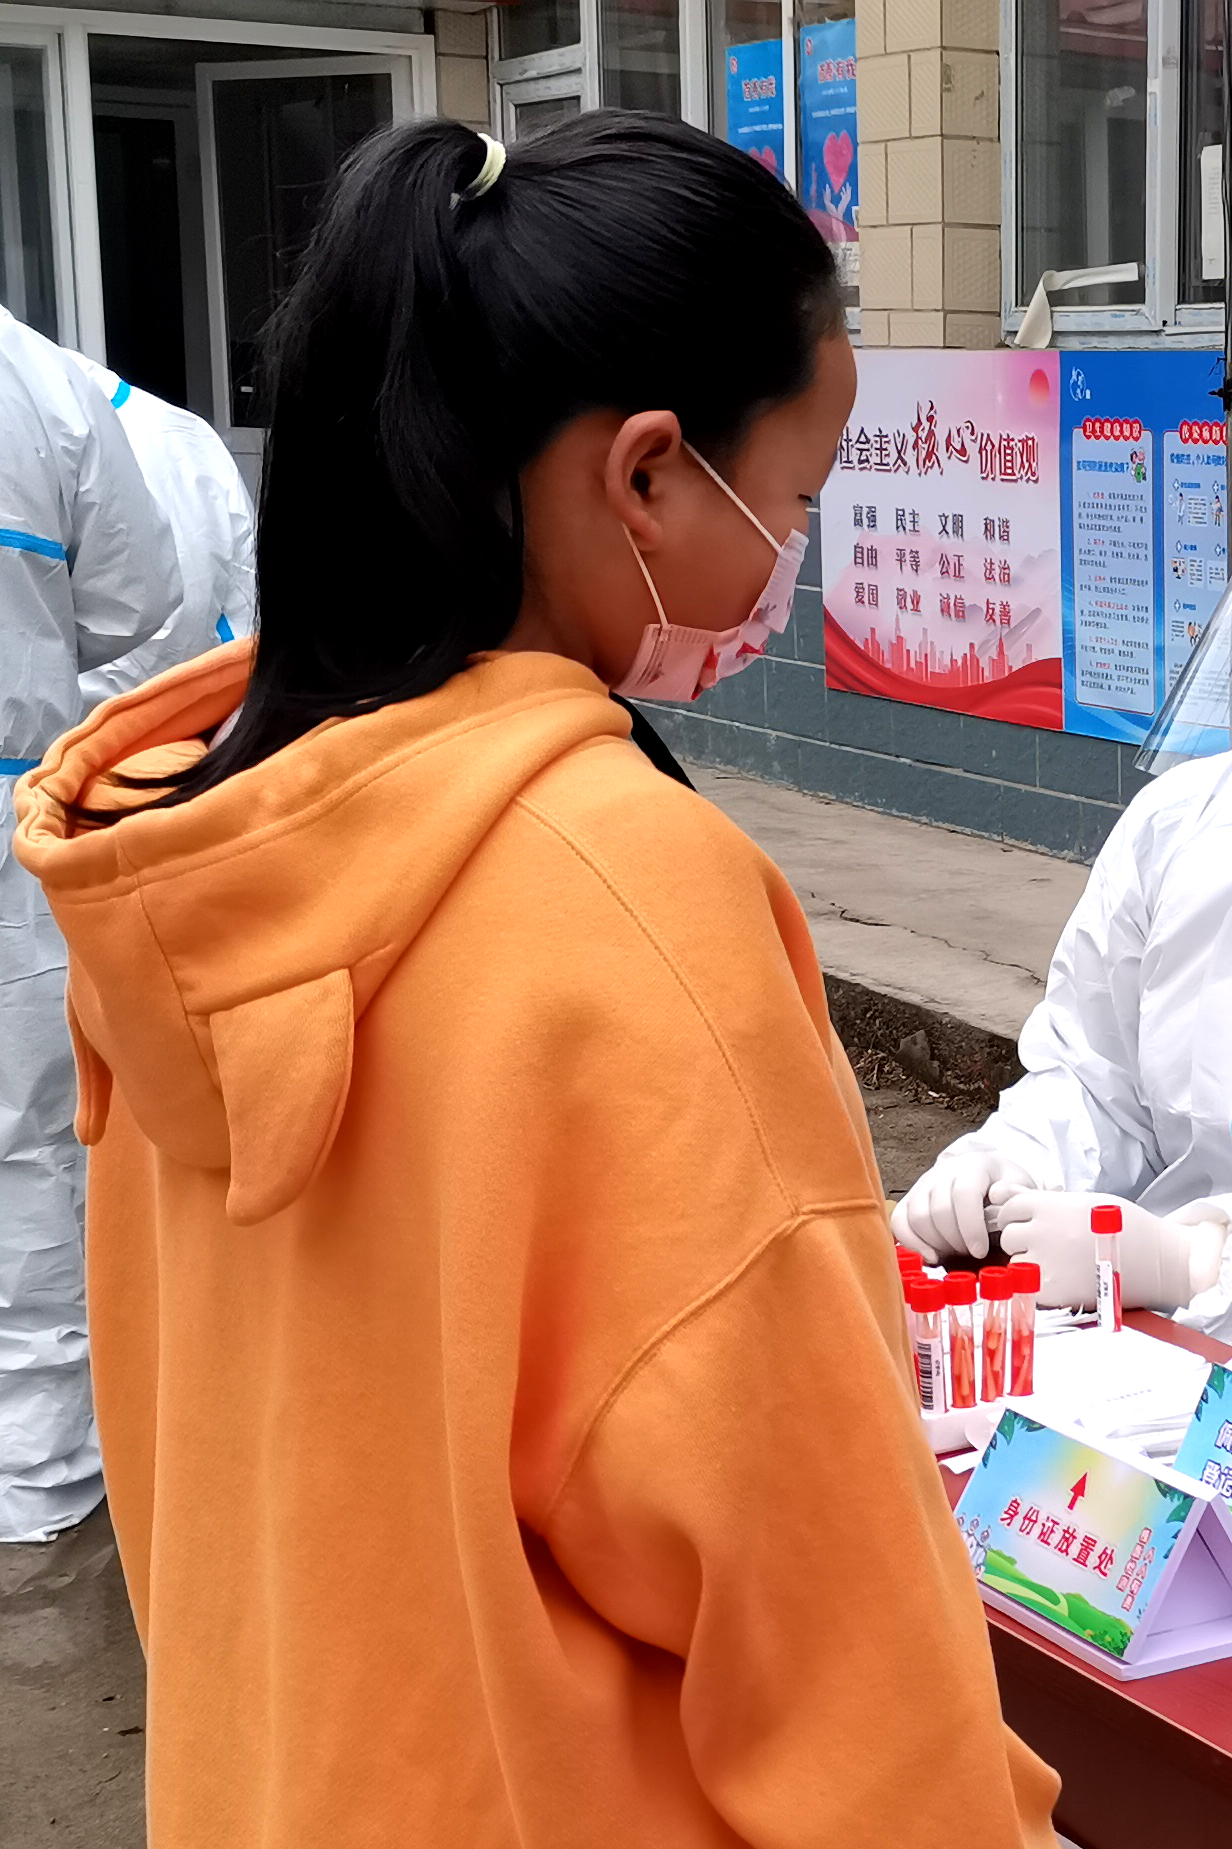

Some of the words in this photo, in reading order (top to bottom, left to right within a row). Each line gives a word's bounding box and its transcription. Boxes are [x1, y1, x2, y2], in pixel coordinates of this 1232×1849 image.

[838, 400, 1040, 484] 社会主义核心价值观
[853, 504, 878, 531] 富强
[895, 509, 920, 534] 民主
[938, 513, 964, 540] 文明
[983, 517, 1011, 544] 和谐
[853, 543, 878, 569] 自由
[895, 548, 921, 575] 平等
[938, 554, 965, 580] 公正
[983, 557, 1011, 585] 法治
[854, 582, 879, 607] 爱国
[896, 588, 921, 614] 敬业
[939, 593, 966, 620] 诚信
[984, 599, 1012, 627] 友善
[1000, 1497, 1117, 1579] 身份证放置处
